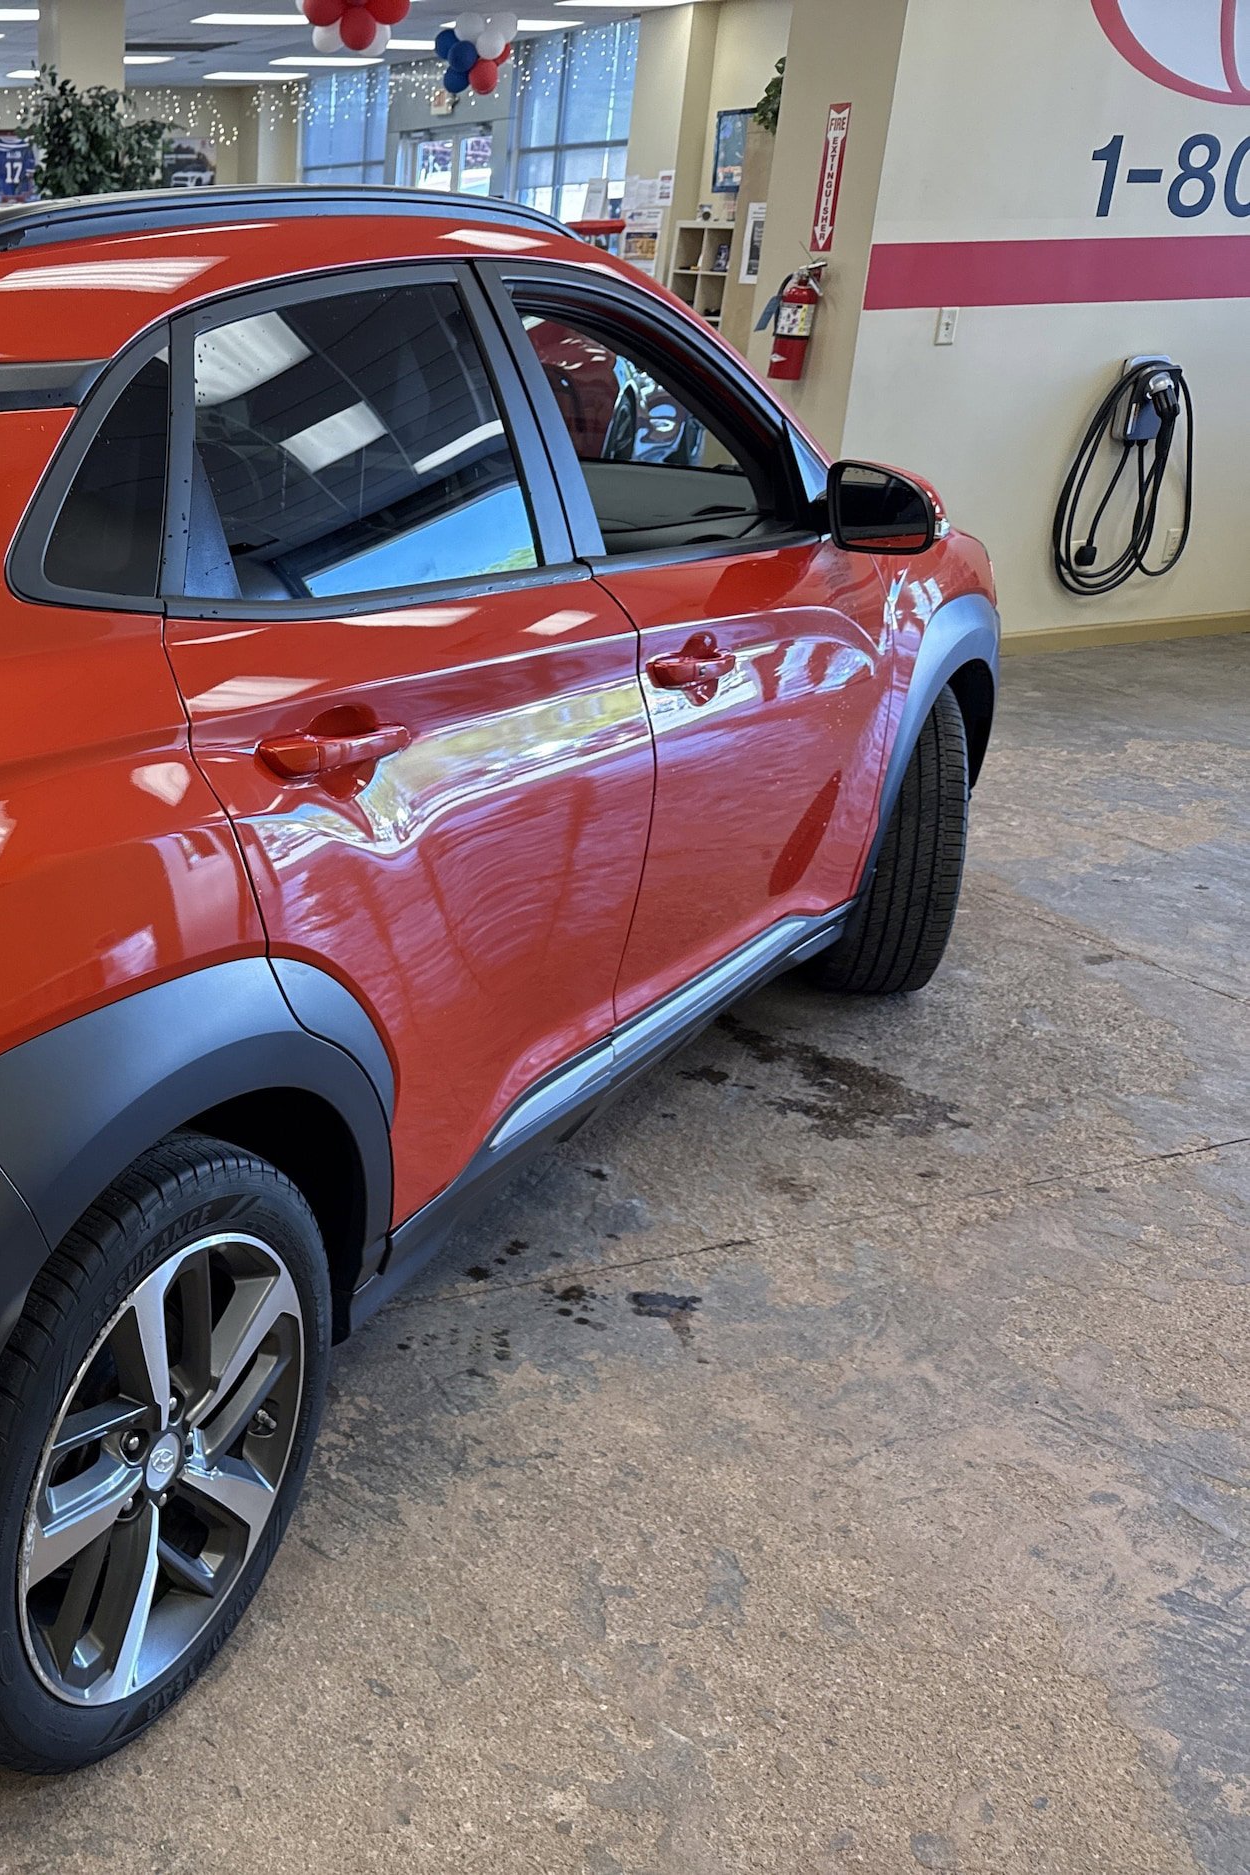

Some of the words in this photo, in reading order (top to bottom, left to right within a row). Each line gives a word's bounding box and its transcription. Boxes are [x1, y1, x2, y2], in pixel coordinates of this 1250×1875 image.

[829, 117, 846, 131] FIRE
[4, 161, 23, 184] 17
[819, 136, 839, 241] EXTINGUISHER
[91, 1204, 213, 1327] ASSURANCE
